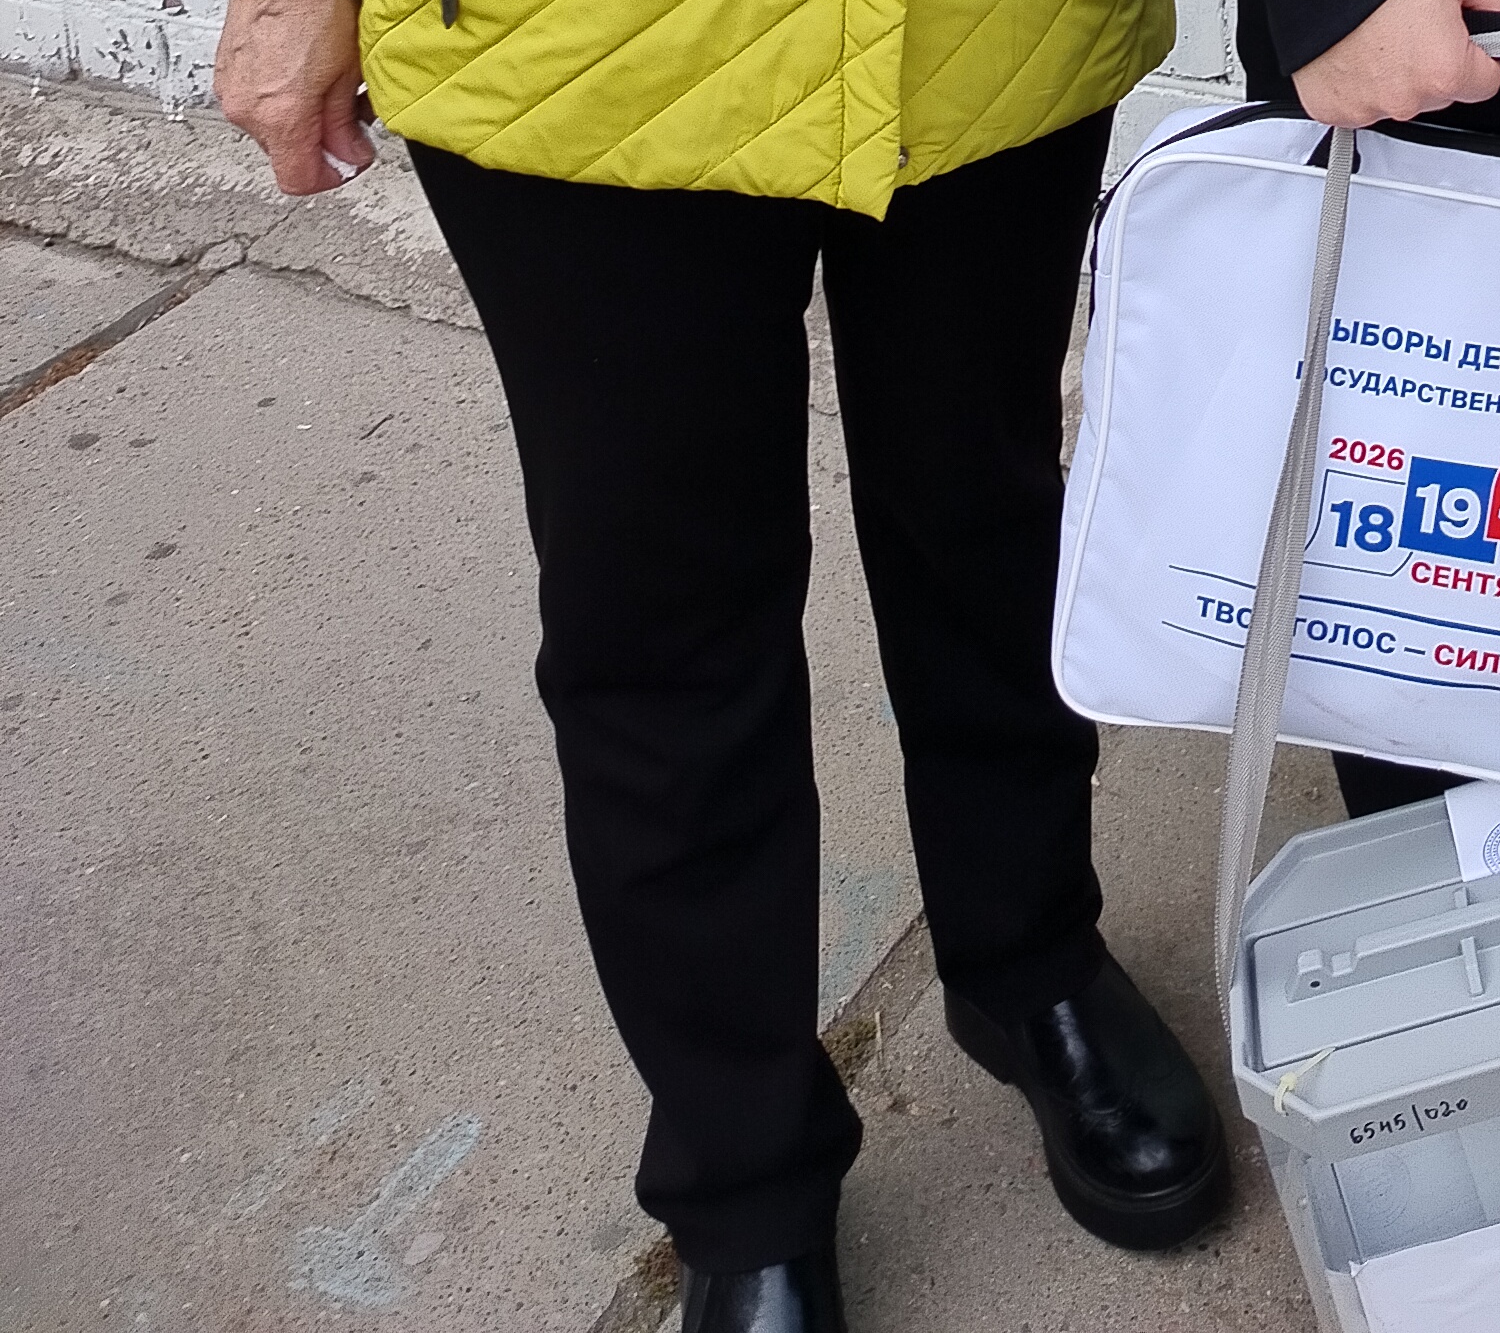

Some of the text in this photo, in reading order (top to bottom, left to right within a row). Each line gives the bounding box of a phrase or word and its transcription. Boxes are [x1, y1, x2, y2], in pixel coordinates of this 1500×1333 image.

[1328, 318, 1451, 361] ЫБОРЫ
[1328, 437, 1405, 470] 2026
[1330, 500, 1395, 553] 18
[1416, 483, 1482, 539] 19
[1196, 595, 1252, 629] ТВО
[1293, 616, 1396, 654] ГОЛОС
